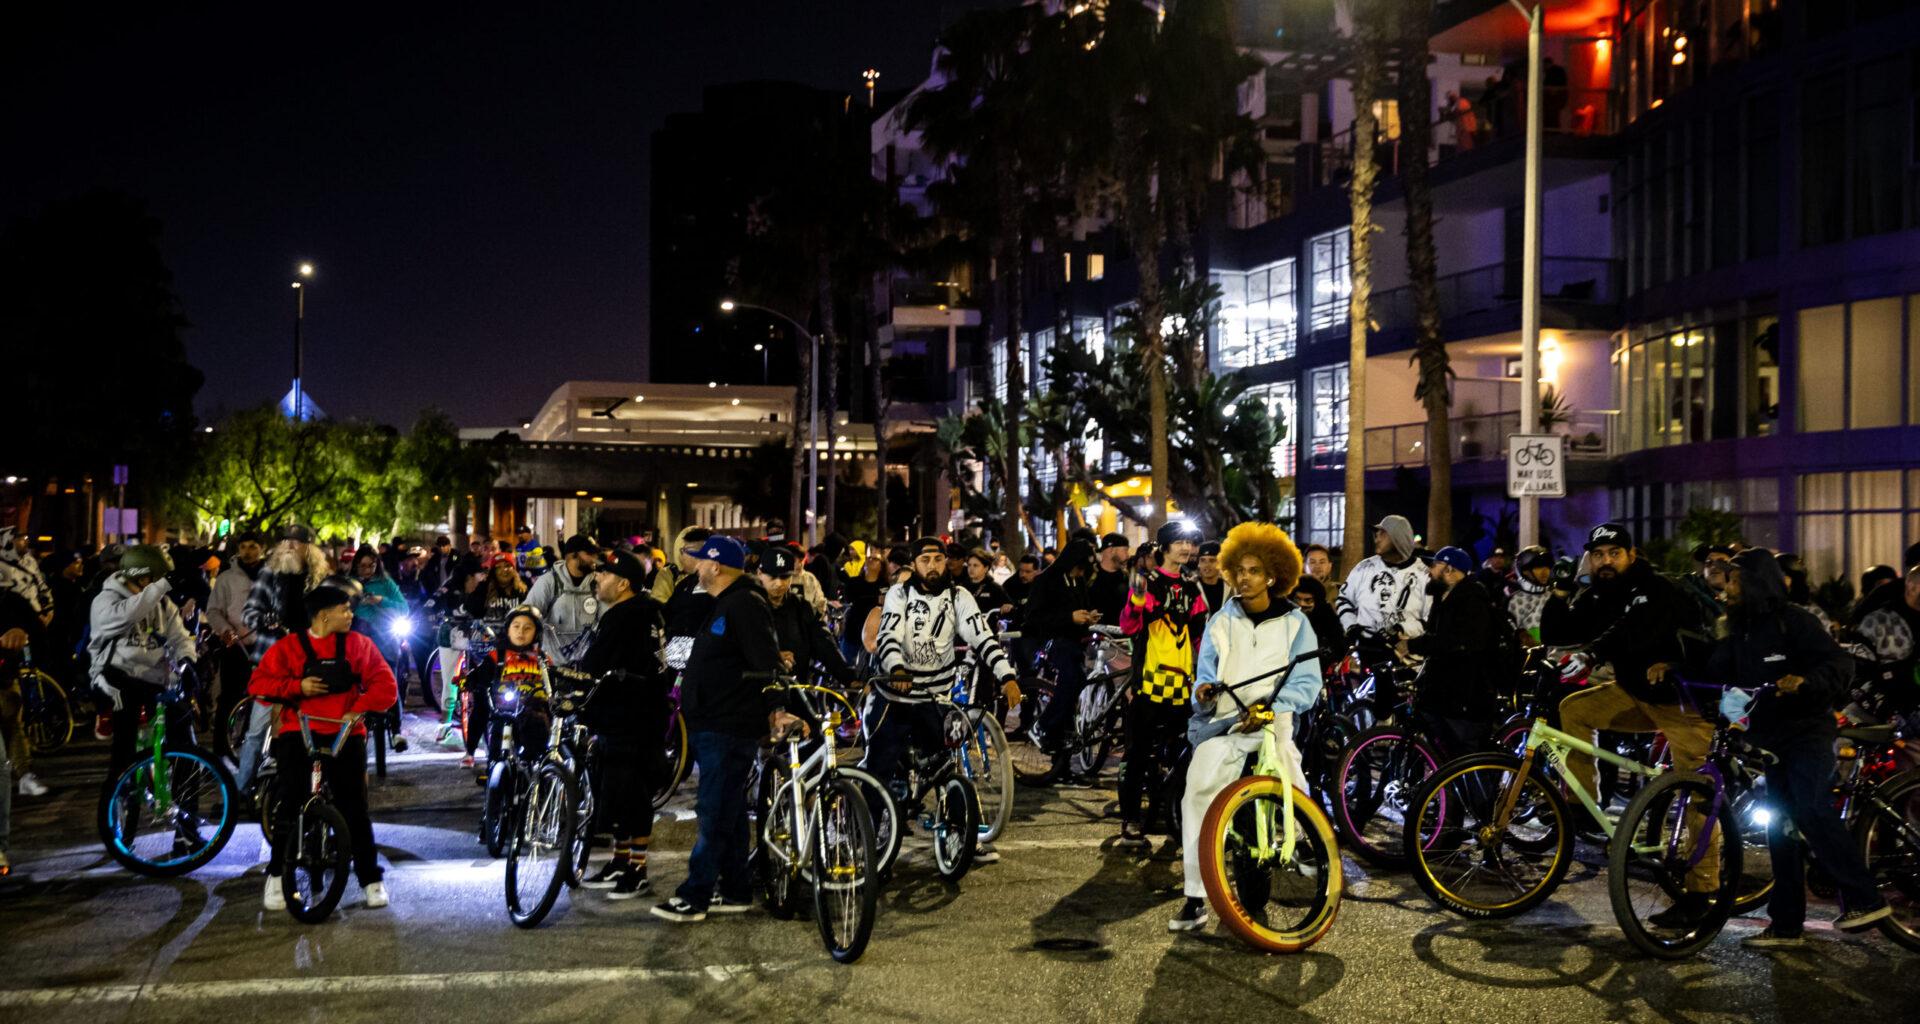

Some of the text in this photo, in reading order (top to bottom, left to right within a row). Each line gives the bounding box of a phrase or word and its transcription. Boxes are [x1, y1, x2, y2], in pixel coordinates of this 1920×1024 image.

[1517, 469, 1553, 479] MAY USE
[1513, 481, 1559, 491] FUL LANE
